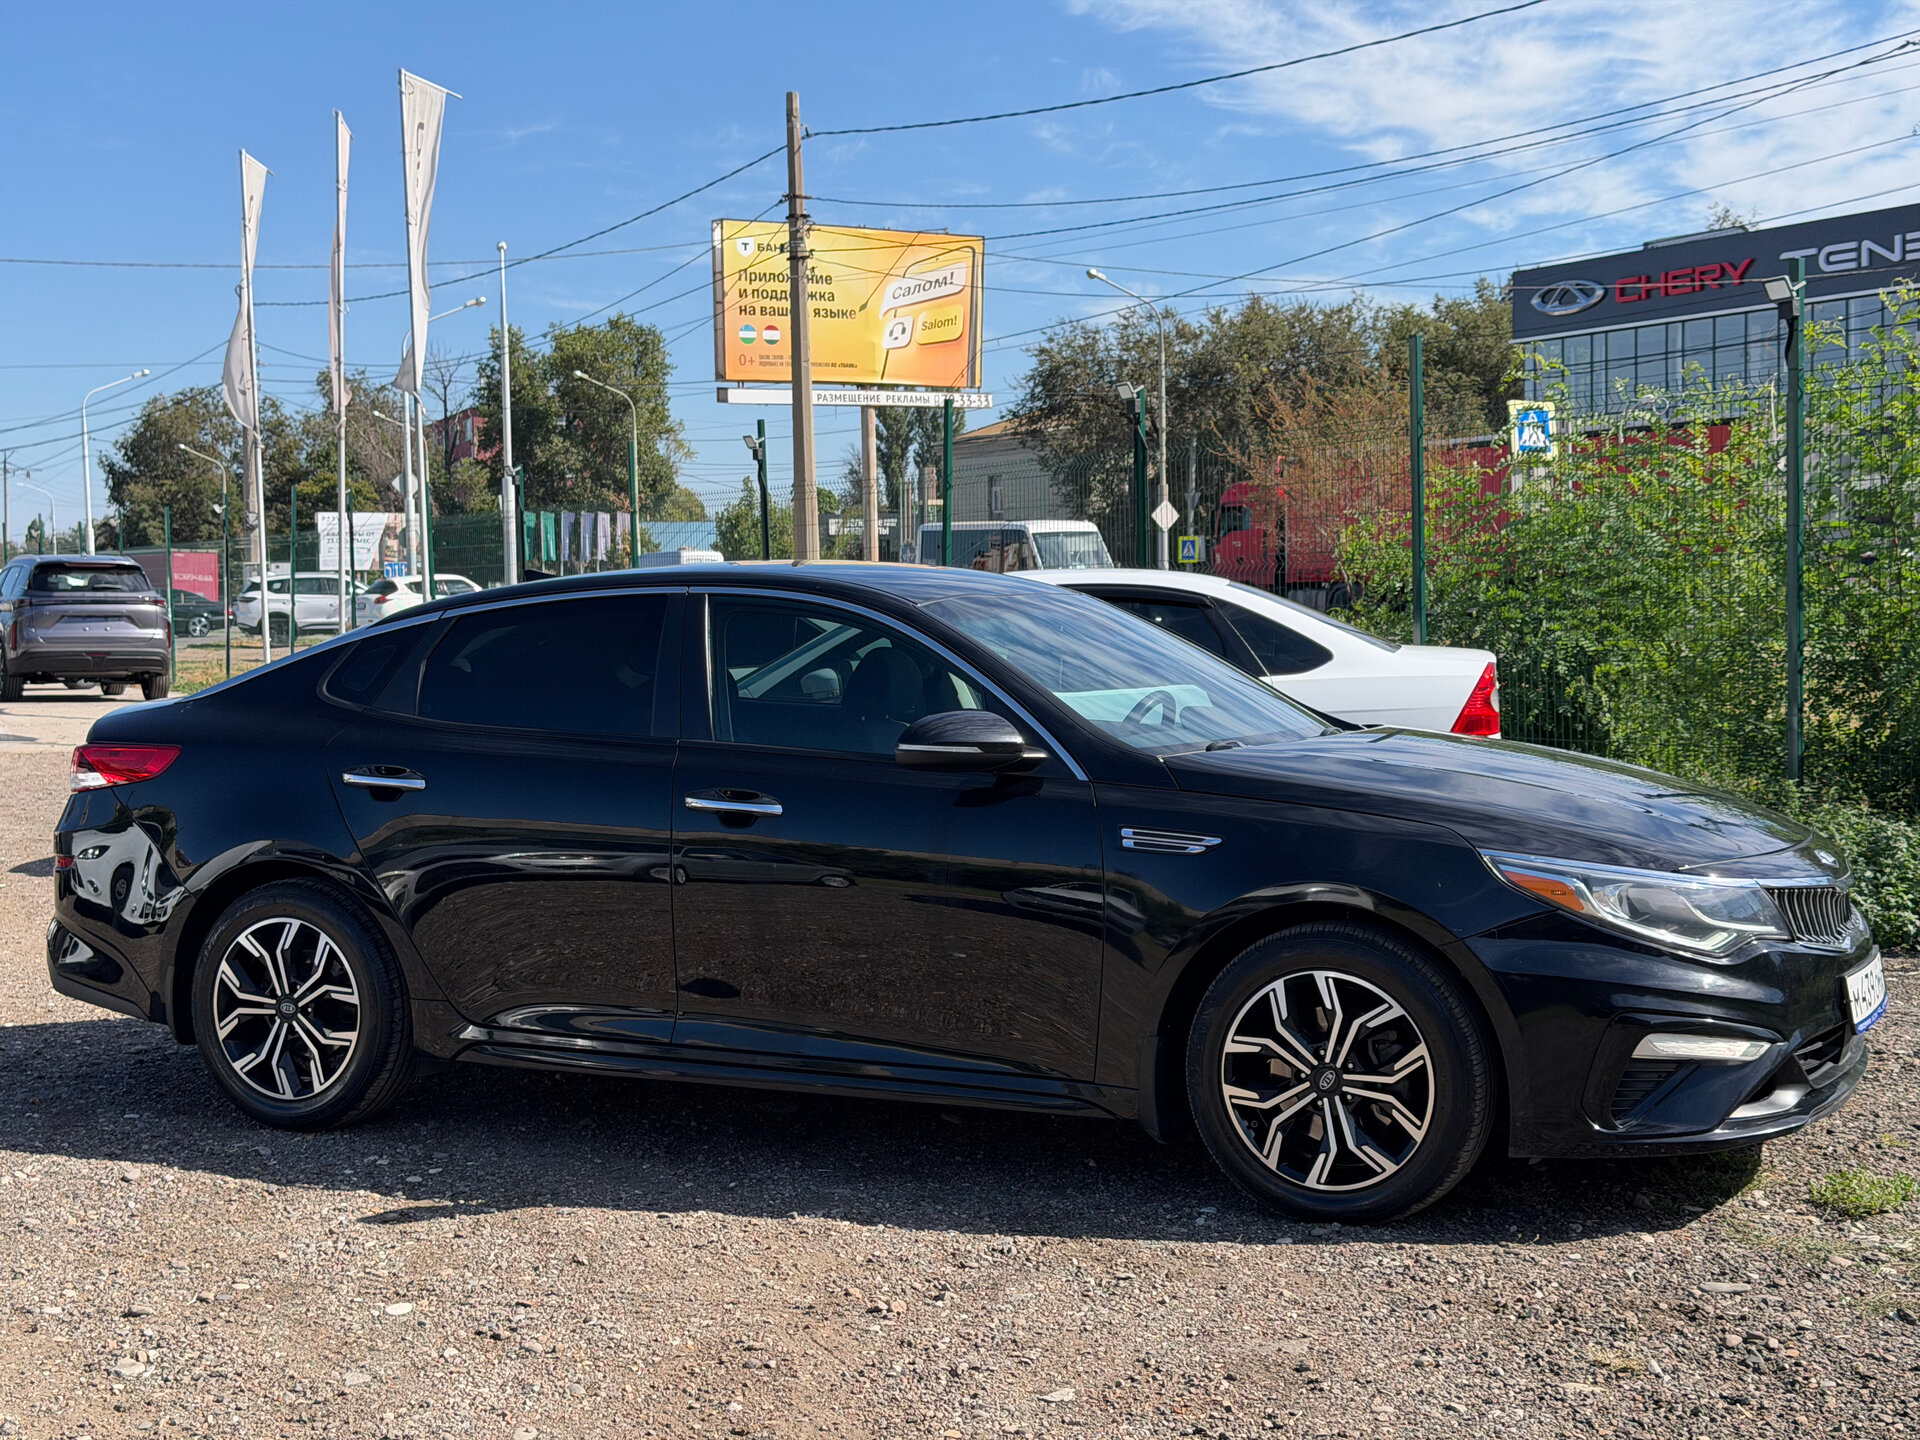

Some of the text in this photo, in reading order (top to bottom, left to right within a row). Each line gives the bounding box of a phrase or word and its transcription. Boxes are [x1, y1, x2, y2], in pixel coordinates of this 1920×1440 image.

[738, 268, 833, 286] Прилоние
[1615, 258, 1756, 303] CHERY
[892, 271, 954, 300] Салом!
[738, 288, 835, 302] и подджка
[739, 305, 756, 316] на
[813, 308, 857, 320] языке
[921, 315, 957, 331] Salom!
[738, 353, 755, 366] 0+
[816, 393, 881, 404] РАЗМЕЩЕНИЕ
[886, 395, 930, 405] РЕКЛАМЫ
